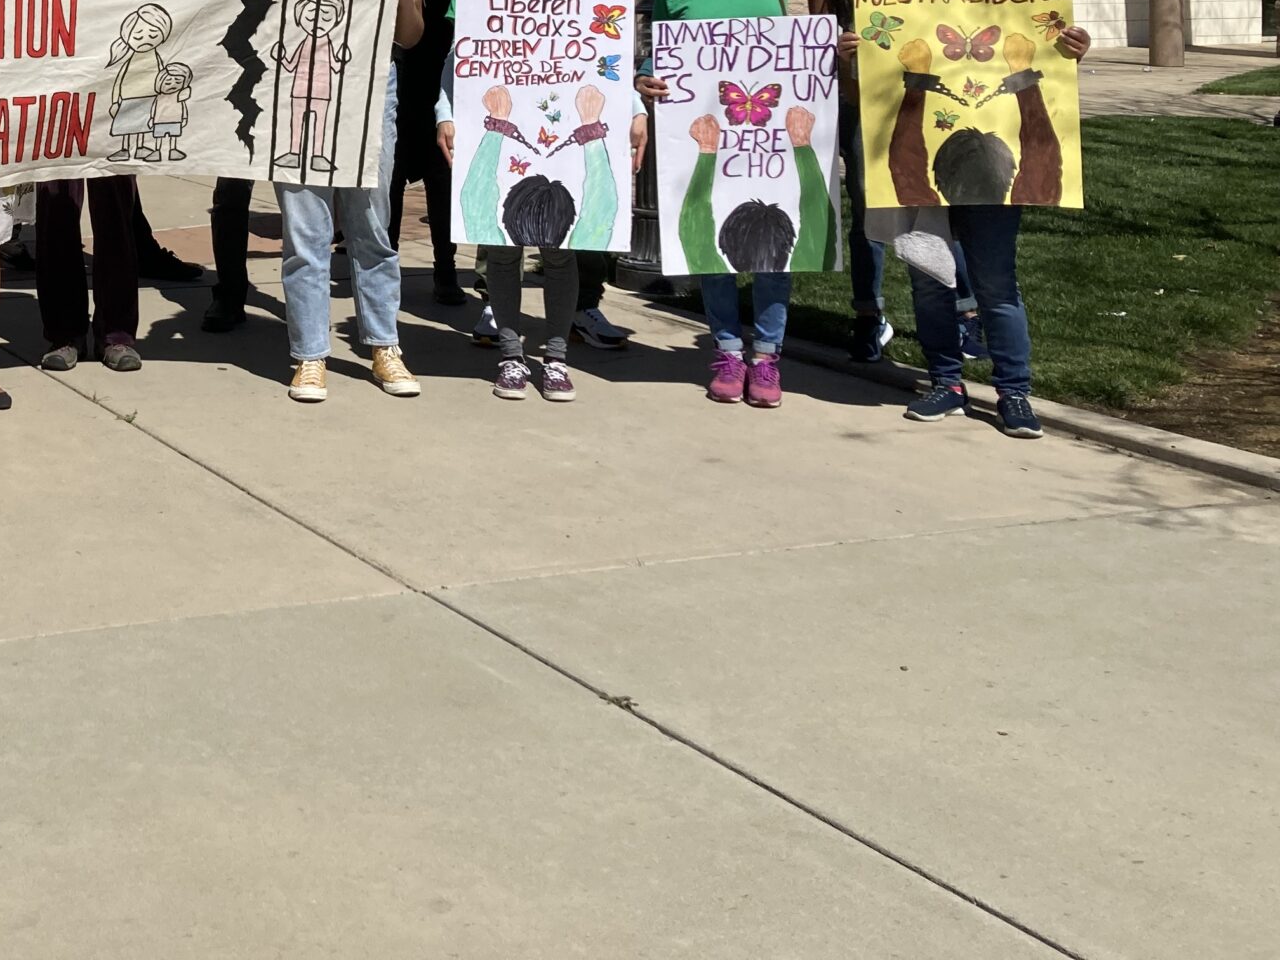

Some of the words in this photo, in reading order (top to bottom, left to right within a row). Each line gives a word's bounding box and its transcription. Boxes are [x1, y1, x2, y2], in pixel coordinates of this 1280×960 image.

[486, 14, 504, 33] a
[656, 16, 777, 47] INMIGRAR
[790, 16, 833, 46] NO
[454, 36, 542, 59] CIERREN
[549, 36, 597, 62] LOS
[654, 45, 685, 71] ES
[697, 44, 740, 73] UN
[747, 43, 838, 77] DELITO
[455, 58, 533, 79] CENTROS
[540, 60, 563, 74] DE
[658, 73, 696, 105] ES
[792, 73, 836, 103] UN
[719, 128, 787, 153] DERE
[722, 152, 785, 179] CHO
